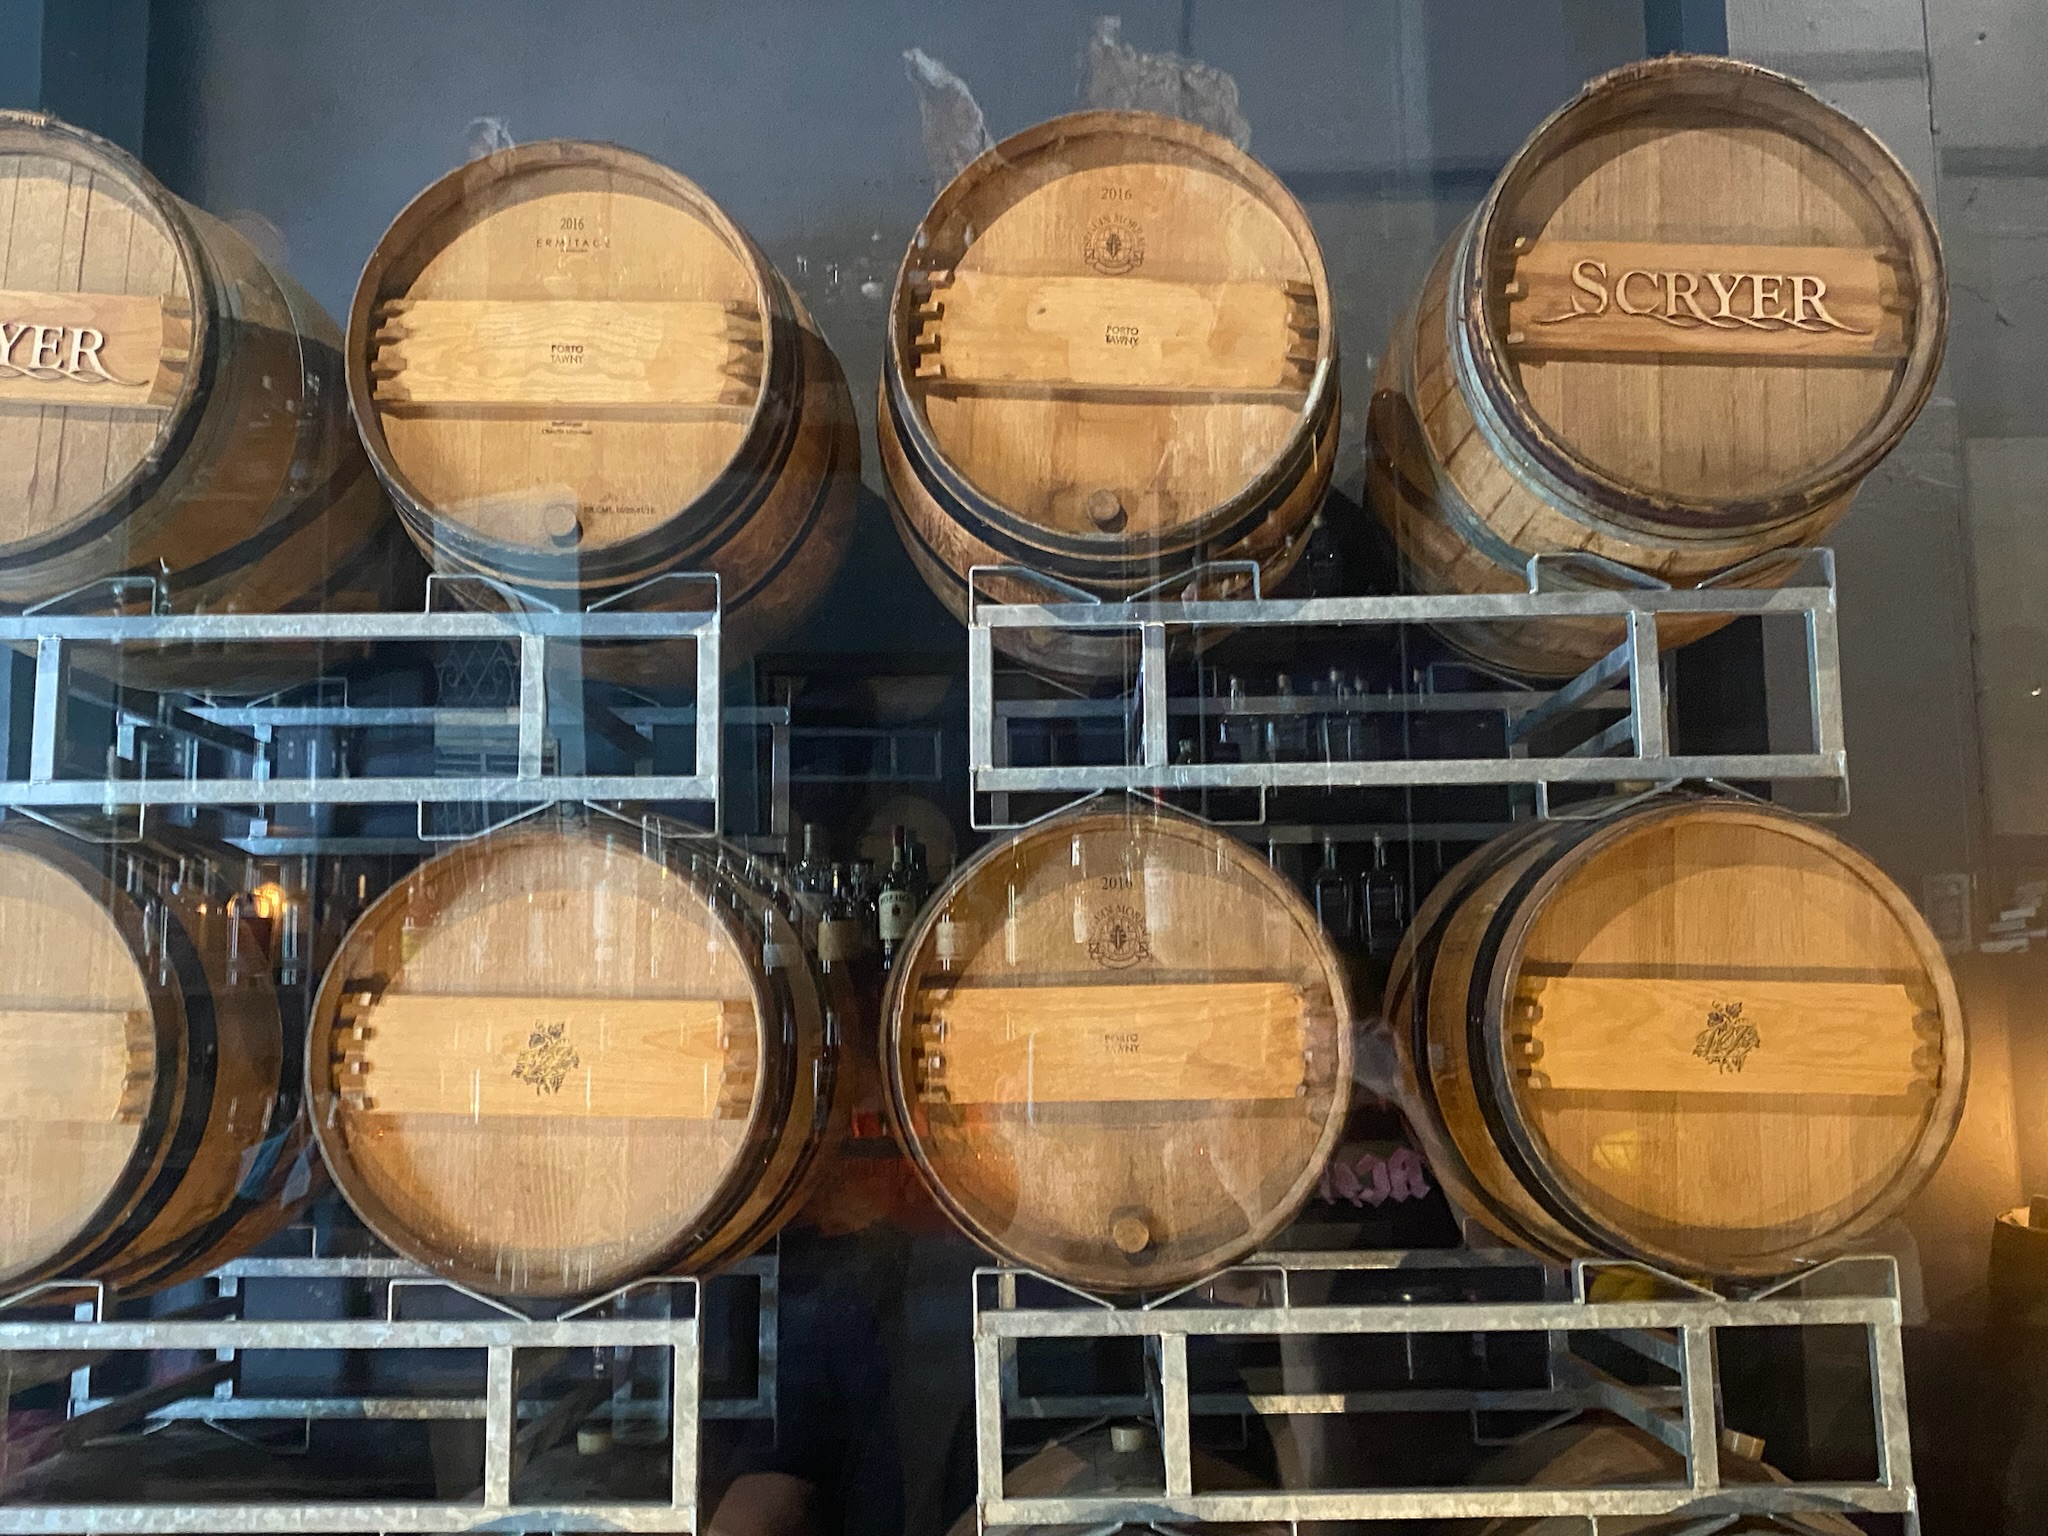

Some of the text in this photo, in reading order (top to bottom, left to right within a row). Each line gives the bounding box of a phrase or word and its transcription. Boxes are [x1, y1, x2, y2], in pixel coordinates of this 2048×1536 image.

[1101, 188, 1132, 200] 2016
[560, 217, 584, 230] 2016
[1533, 259, 1873, 336] SCRYER
[1106, 325, 1139, 336] PORTO
[1105, 335, 1139, 346] TAWNY
[551, 344, 584, 353] PORTO
[550, 354, 584, 364] TAWNY
[1101, 877, 1133, 890] 2016
